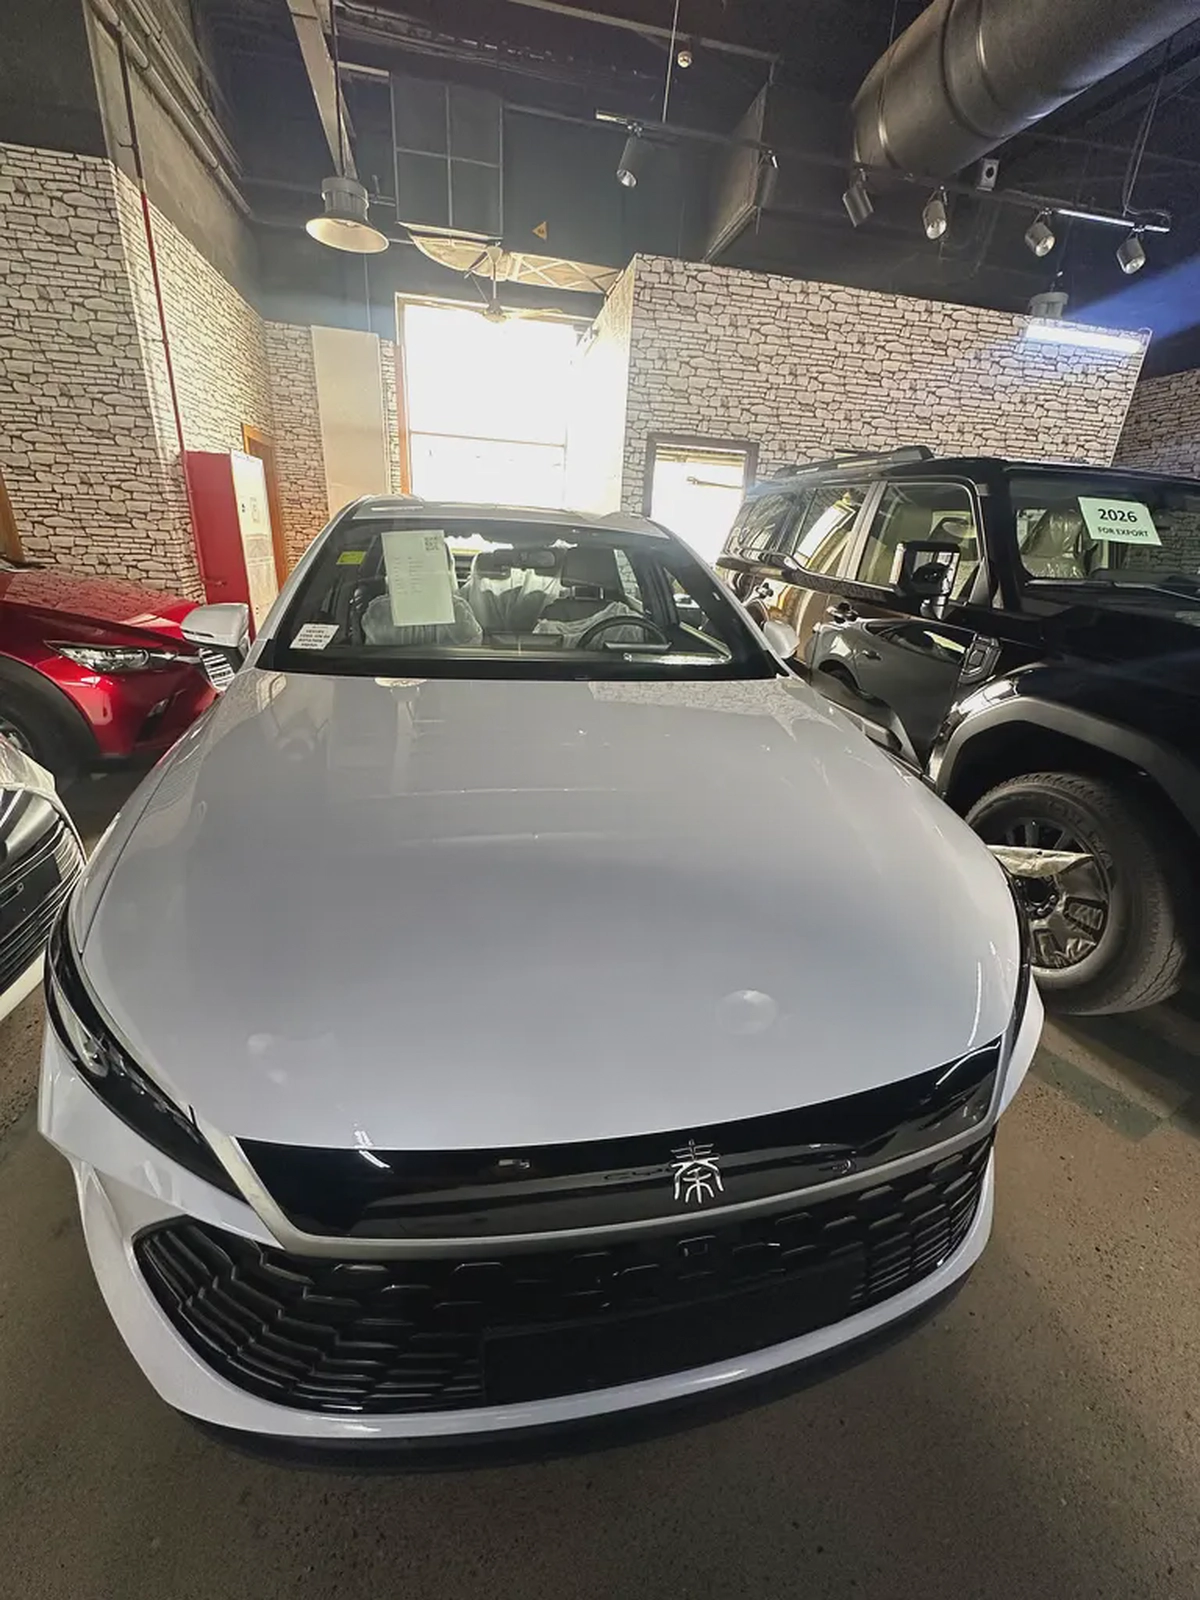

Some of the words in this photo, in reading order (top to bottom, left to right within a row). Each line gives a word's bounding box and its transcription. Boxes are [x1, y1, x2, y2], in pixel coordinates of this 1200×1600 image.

[1098, 508, 1138, 523] 2026
[1097, 526, 1115, 535] FOR
[1115, 528, 1149, 537] EXPORT
